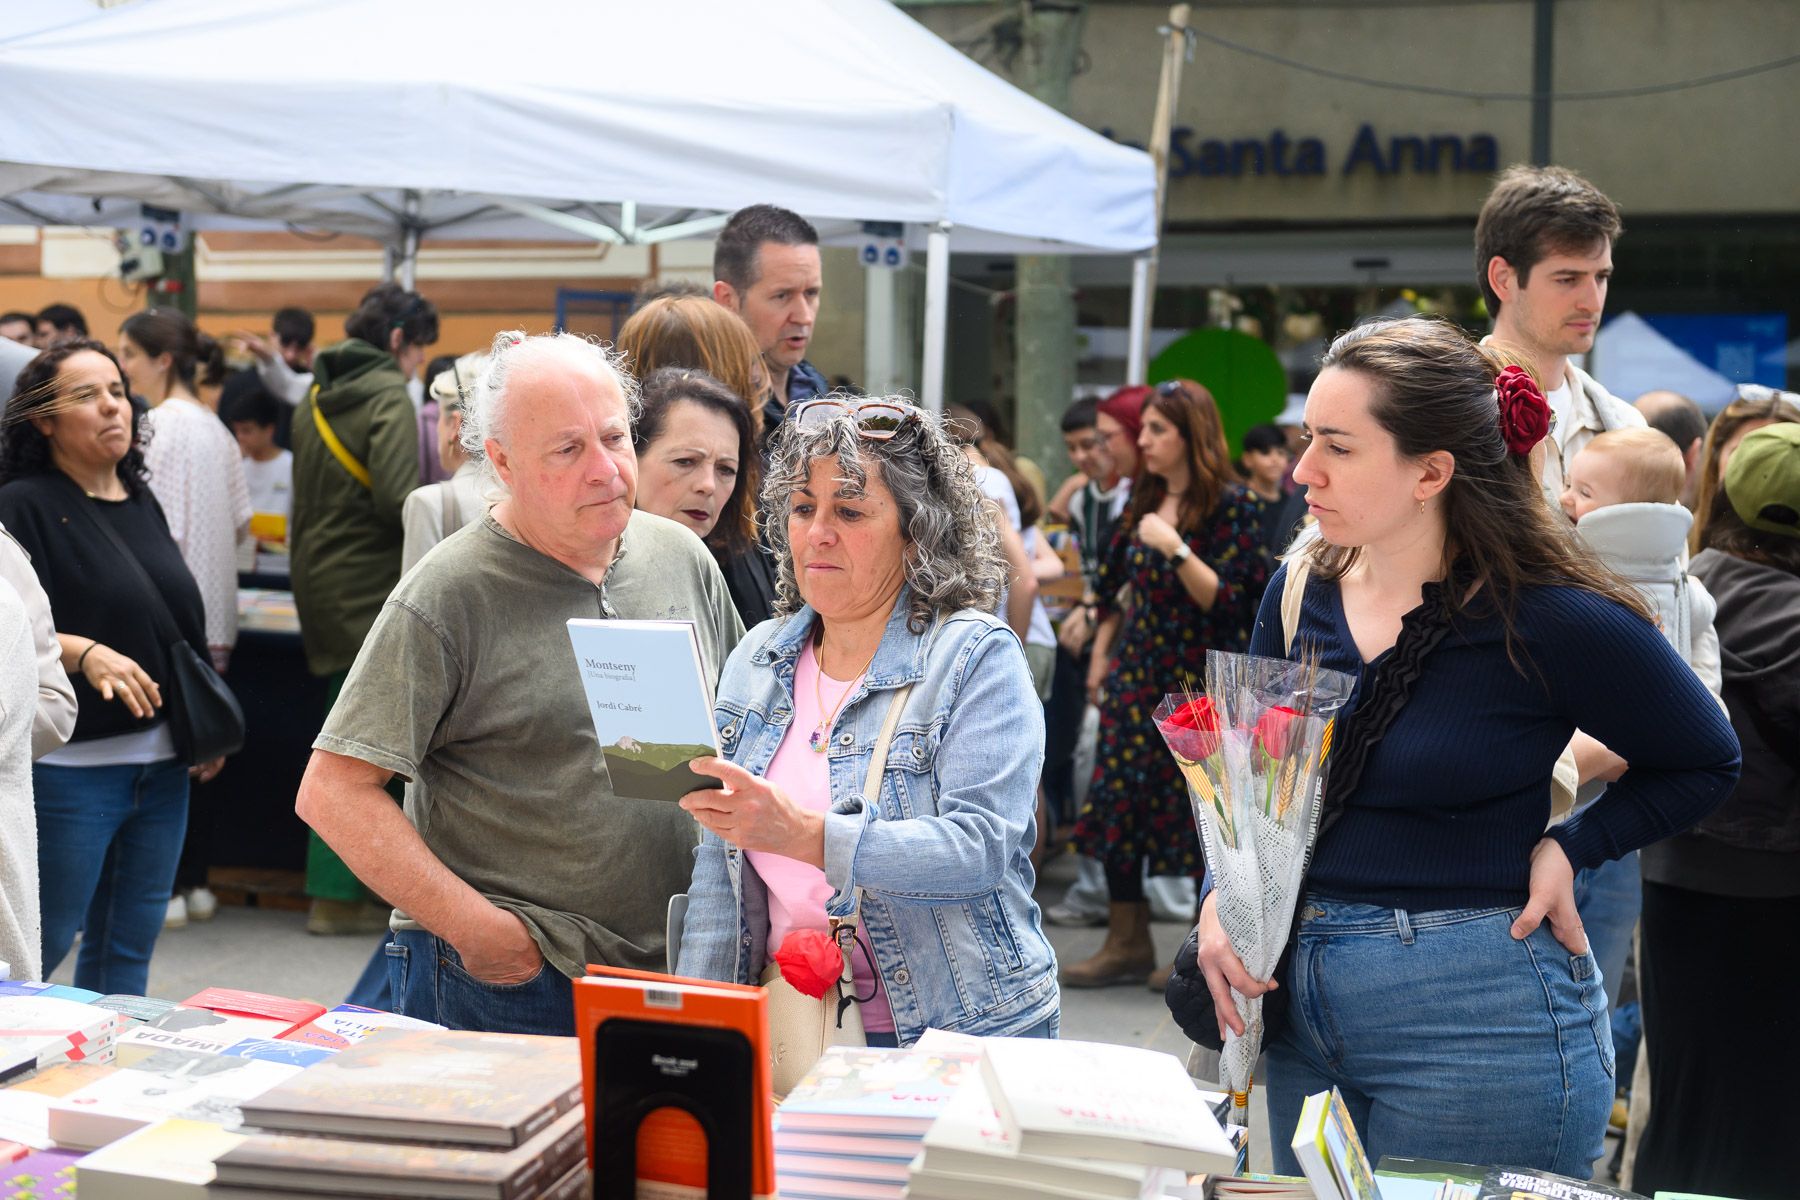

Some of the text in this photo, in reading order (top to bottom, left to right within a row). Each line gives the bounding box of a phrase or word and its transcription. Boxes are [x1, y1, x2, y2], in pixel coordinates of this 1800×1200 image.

[1167, 126, 1327, 177] Santa
[1344, 122, 1498, 175] Anna
[584, 658, 636, 674] Montseny
[596, 700, 643, 712] Jordi Cabré
